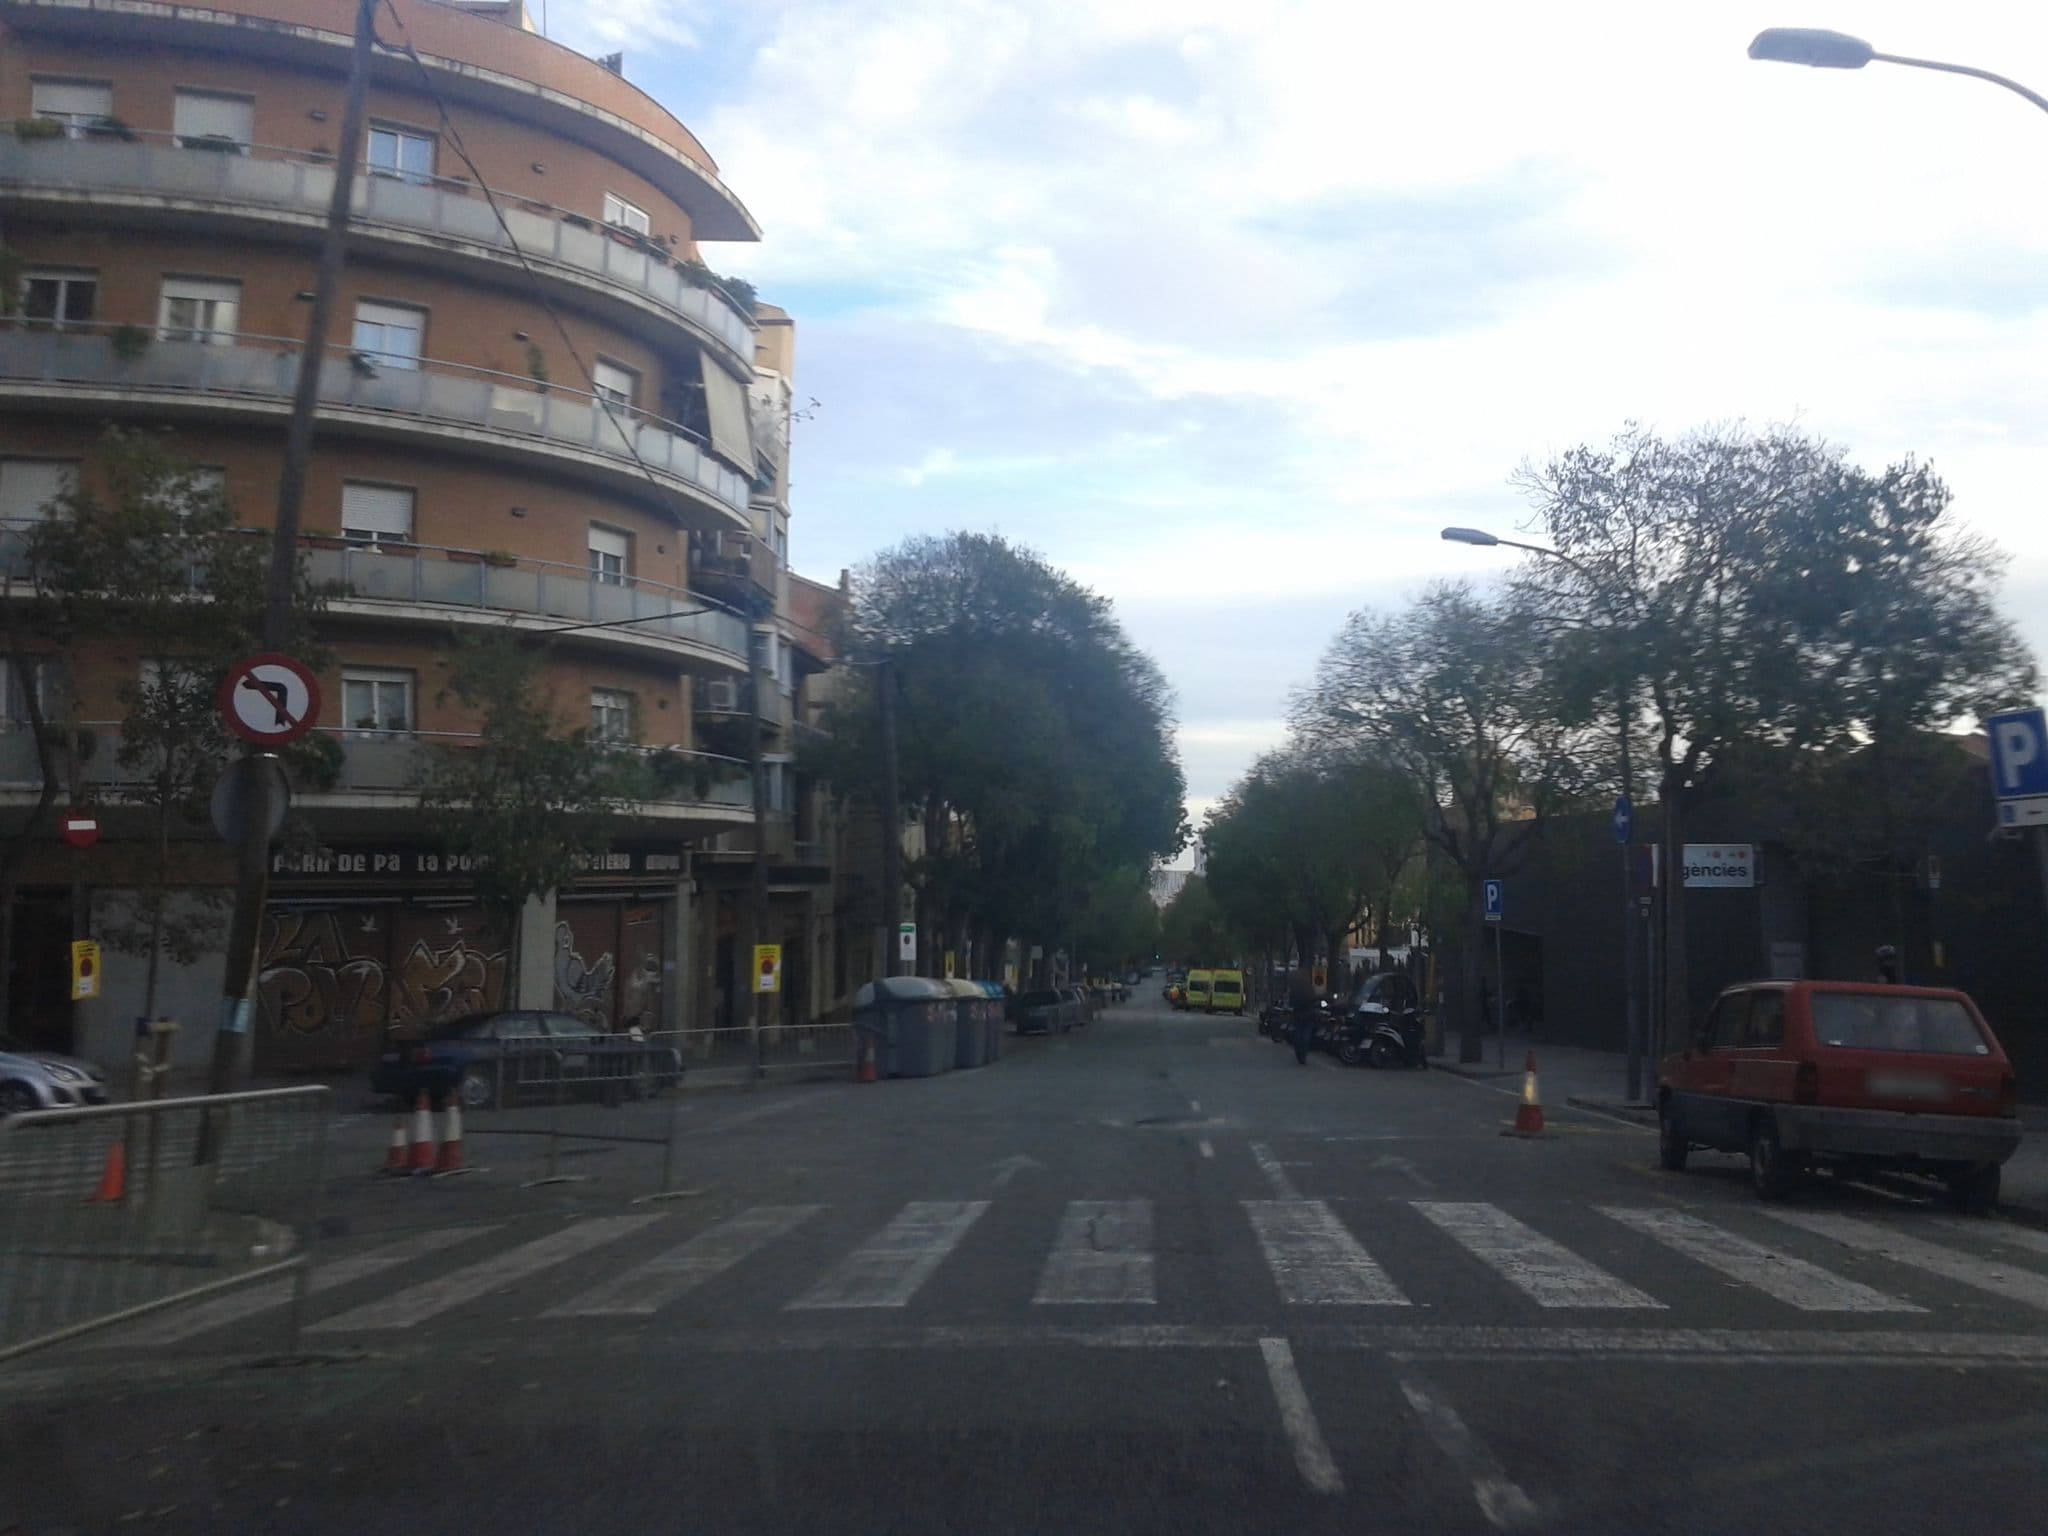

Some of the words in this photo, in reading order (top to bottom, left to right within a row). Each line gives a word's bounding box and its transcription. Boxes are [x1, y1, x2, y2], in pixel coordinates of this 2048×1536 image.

[1995, 721, 2037, 788] P
[338, 853, 366, 872] DE
[1487, 884, 1498, 910] P
